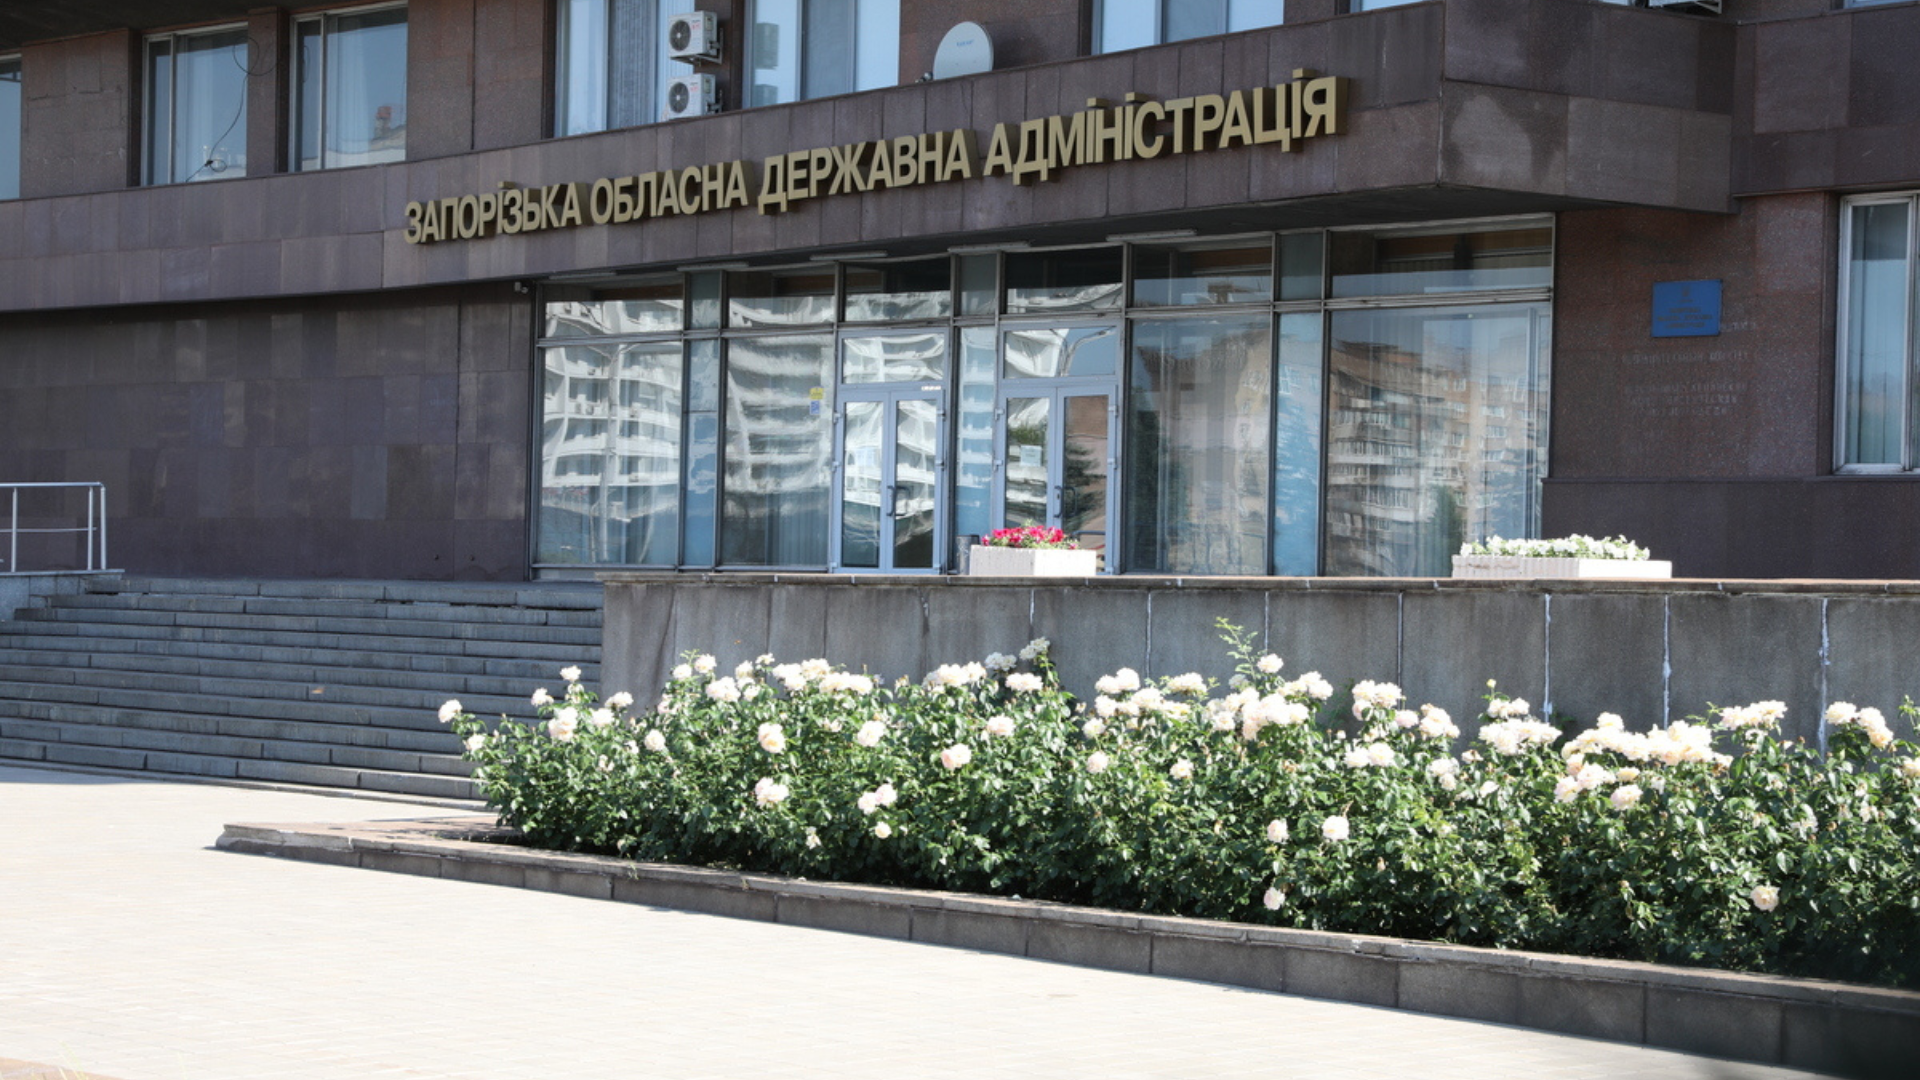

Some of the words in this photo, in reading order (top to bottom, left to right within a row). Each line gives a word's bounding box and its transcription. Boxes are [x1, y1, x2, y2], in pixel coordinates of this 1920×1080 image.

[403, 181, 582, 245] ЗАПОРІЗЬКА
[590, 159, 748, 225] ОБЛАСНА
[758, 129, 971, 216] ДЕРЖАВНА
[983, 68, 1337, 186] АДМІНІСТРАЦІЯ
